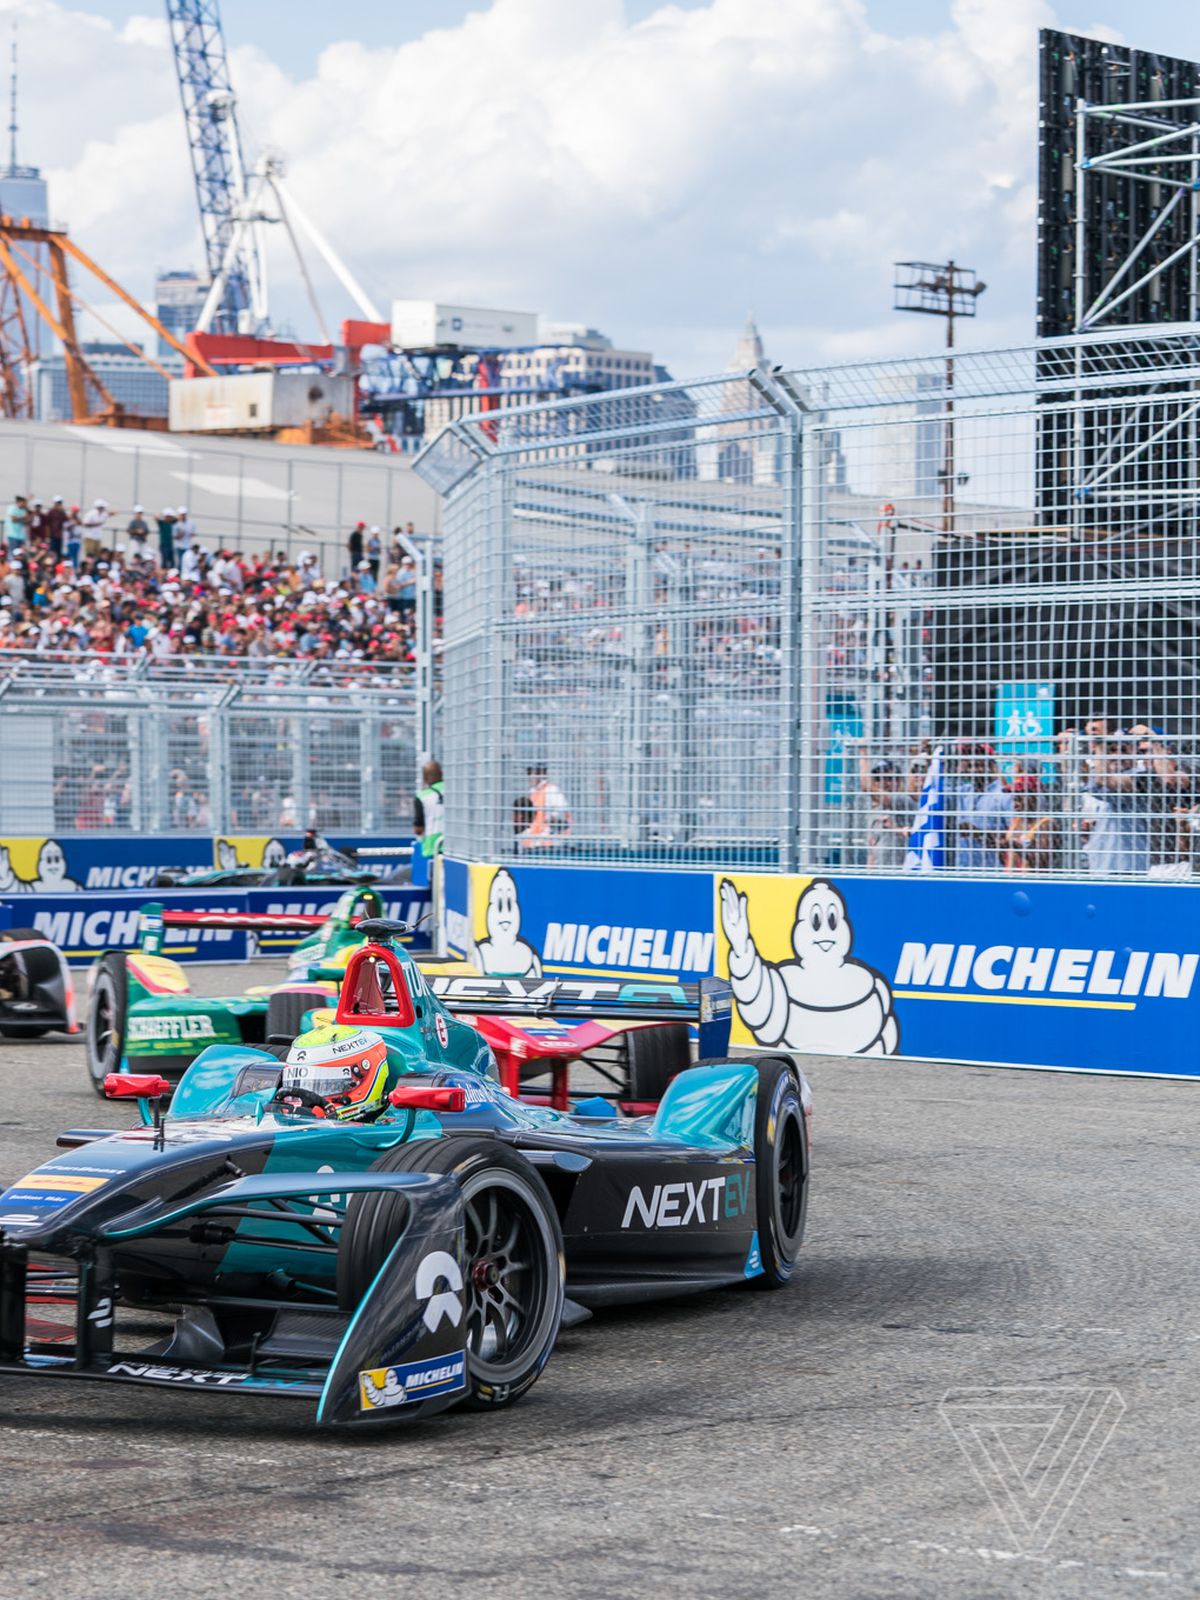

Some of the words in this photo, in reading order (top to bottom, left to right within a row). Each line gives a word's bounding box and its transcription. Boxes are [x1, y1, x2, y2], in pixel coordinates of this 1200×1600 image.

[542, 923, 713, 972] MICHELIN
[894, 942, 1200, 998] MICHELIN
[287, 1067, 309, 1078] NIO
[621, 1170, 749, 1228] NEXTEV
[406, 1361, 464, 1388] MICHELIN
